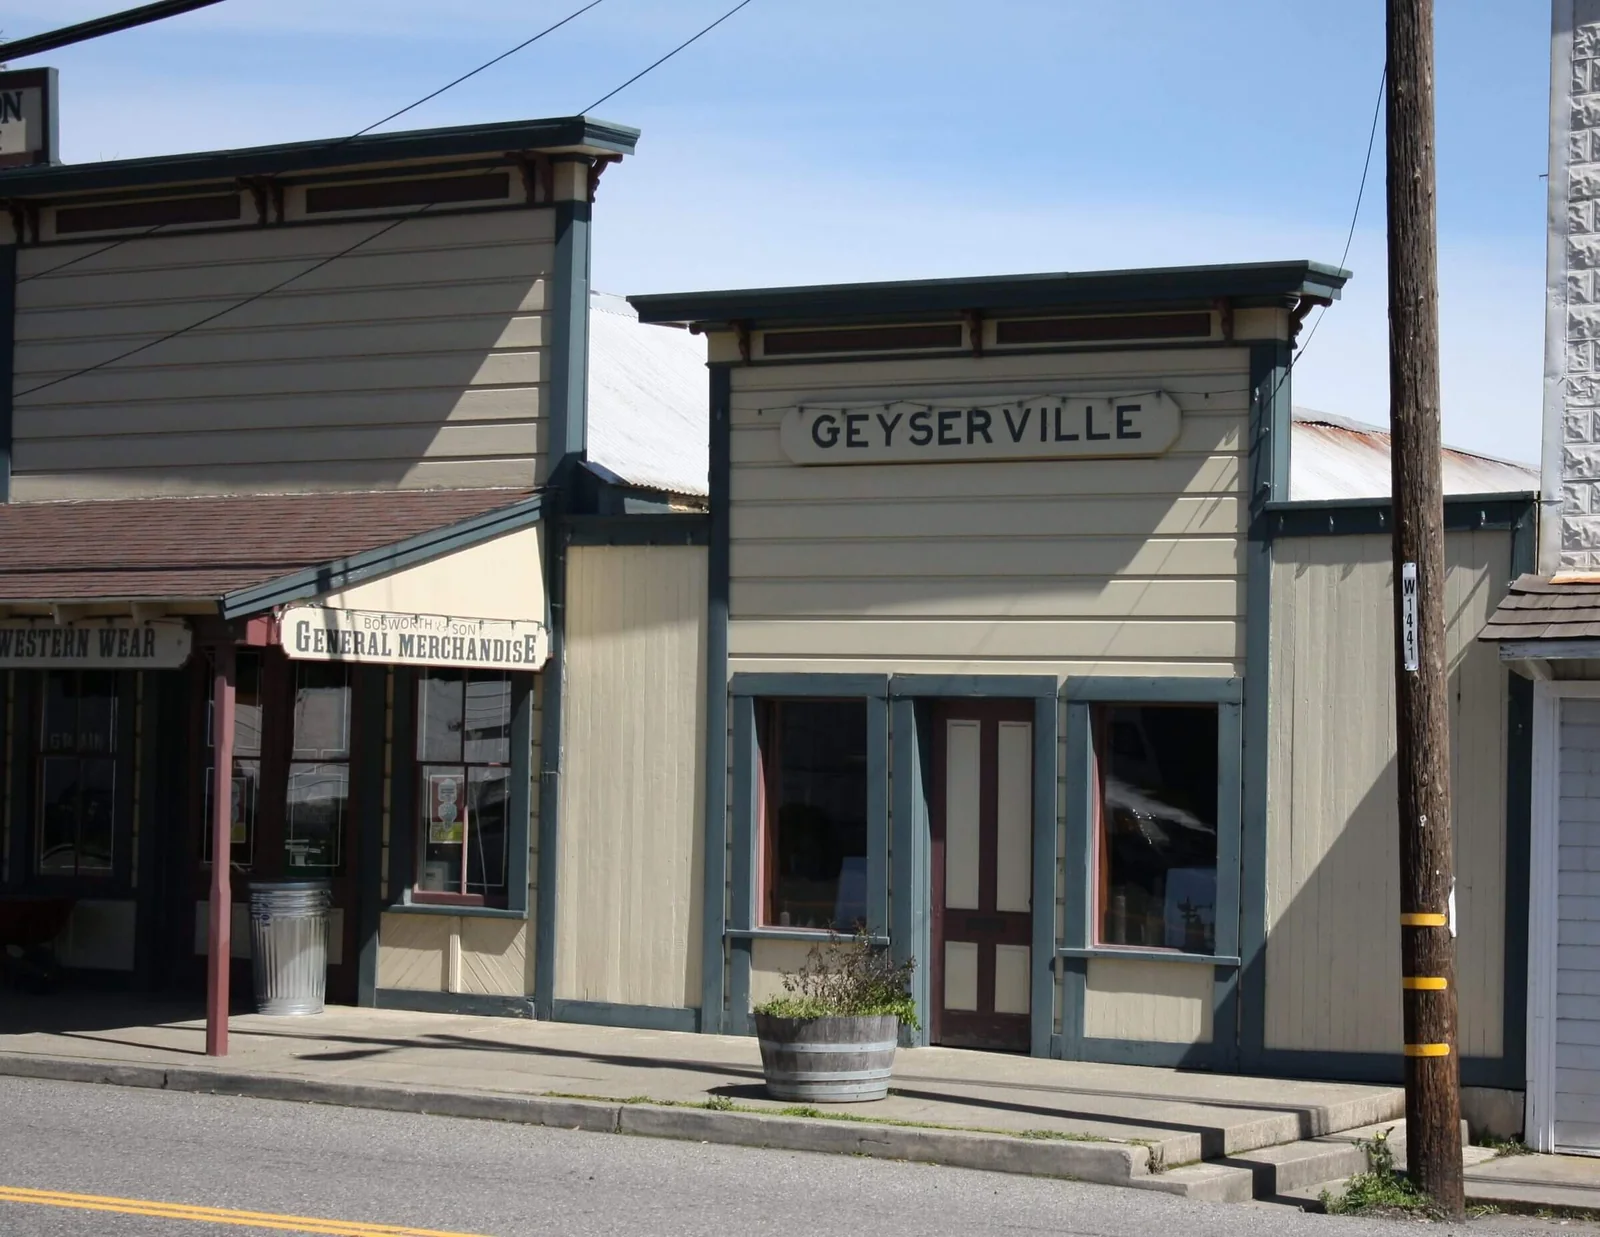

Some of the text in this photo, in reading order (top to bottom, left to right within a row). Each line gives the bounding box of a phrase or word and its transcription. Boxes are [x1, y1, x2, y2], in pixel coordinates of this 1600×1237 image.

[0, 91, 23, 124] N
[811, 404, 1142, 449] GEYSERVILLE
[0, 628, 156, 658] WESTERN WEAR
[296, 620, 537, 664] GENERAL MERCHANDISE
[363, 617, 476, 636] BOSWORTH & SON
